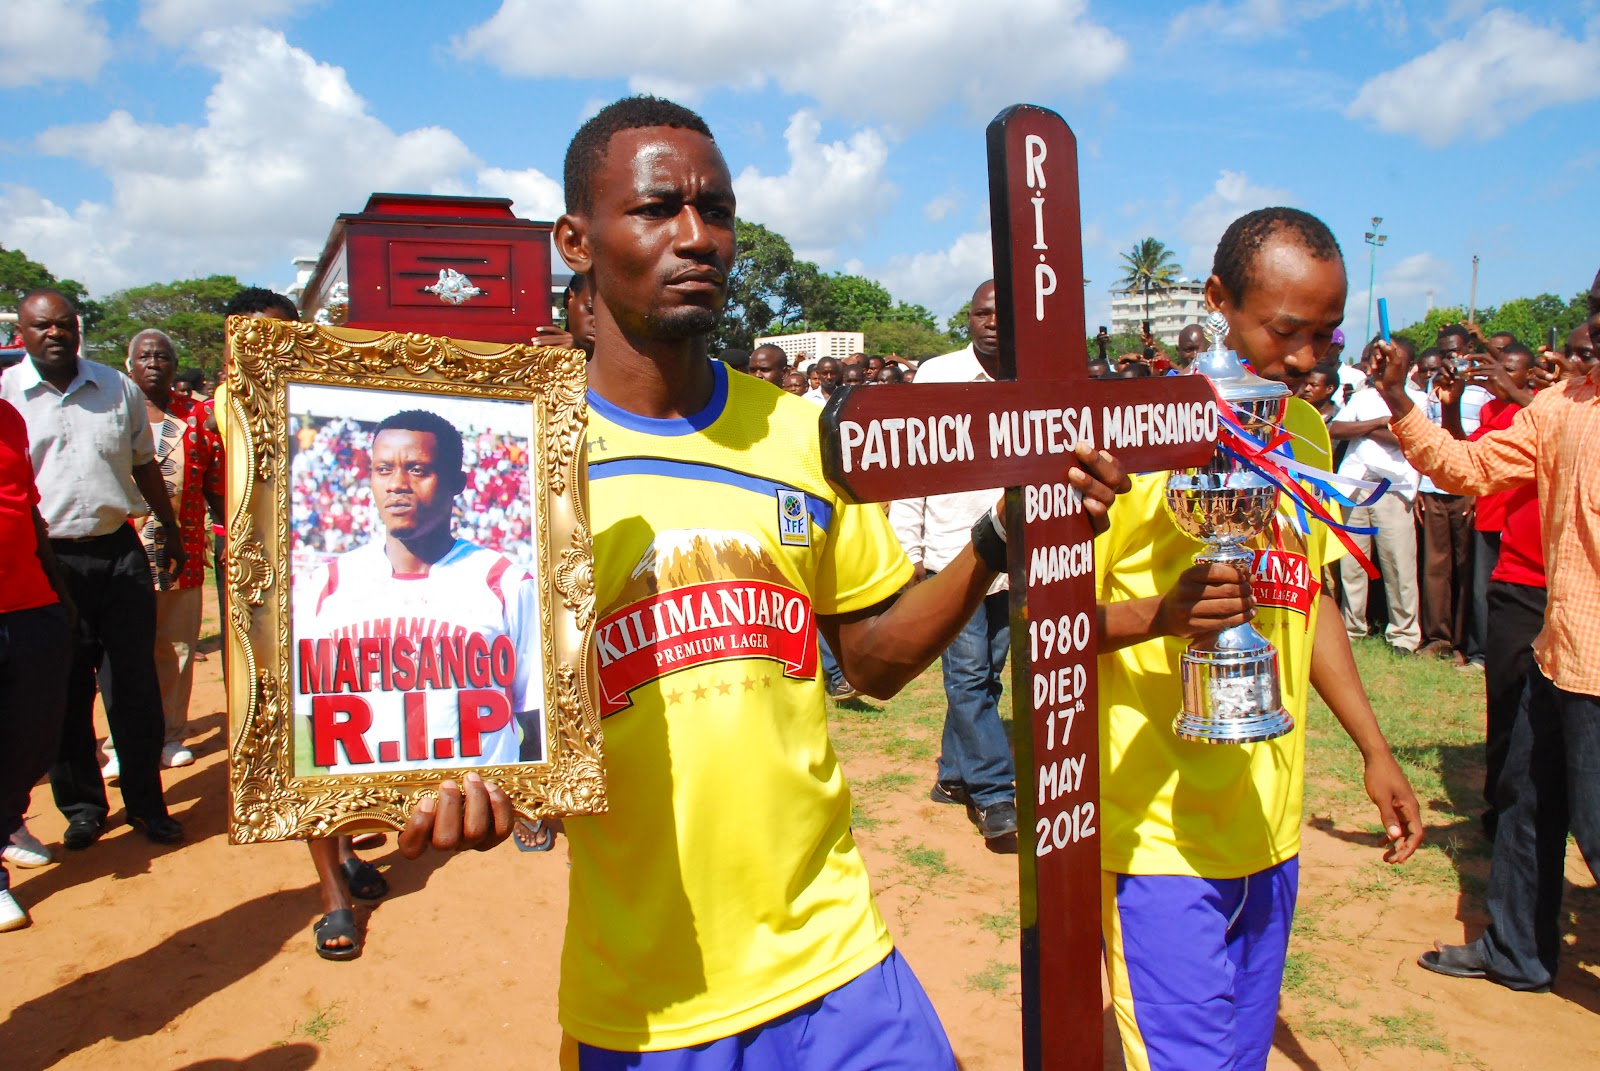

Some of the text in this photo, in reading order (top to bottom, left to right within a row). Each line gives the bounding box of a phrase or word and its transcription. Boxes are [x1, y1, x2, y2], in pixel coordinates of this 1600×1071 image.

[839, 400, 1218, 473] PATRICK MUTESA MAFISANGO
[1025, 483, 1082, 524] BORN
[1028, 539, 1093, 588] MARCH
[596, 587, 805, 668] KILIMANJARO
[653, 632, 769, 667] PREMIUM LAGER
[1028, 612, 1091, 663] 1980
[299, 632, 517, 694] MAFISANGO
[1033, 663, 1087, 710] DIED
[312, 689, 513, 767] R.I.P
[1038, 753, 1087, 806] MAY
[1035, 801, 1096, 857] 2012
